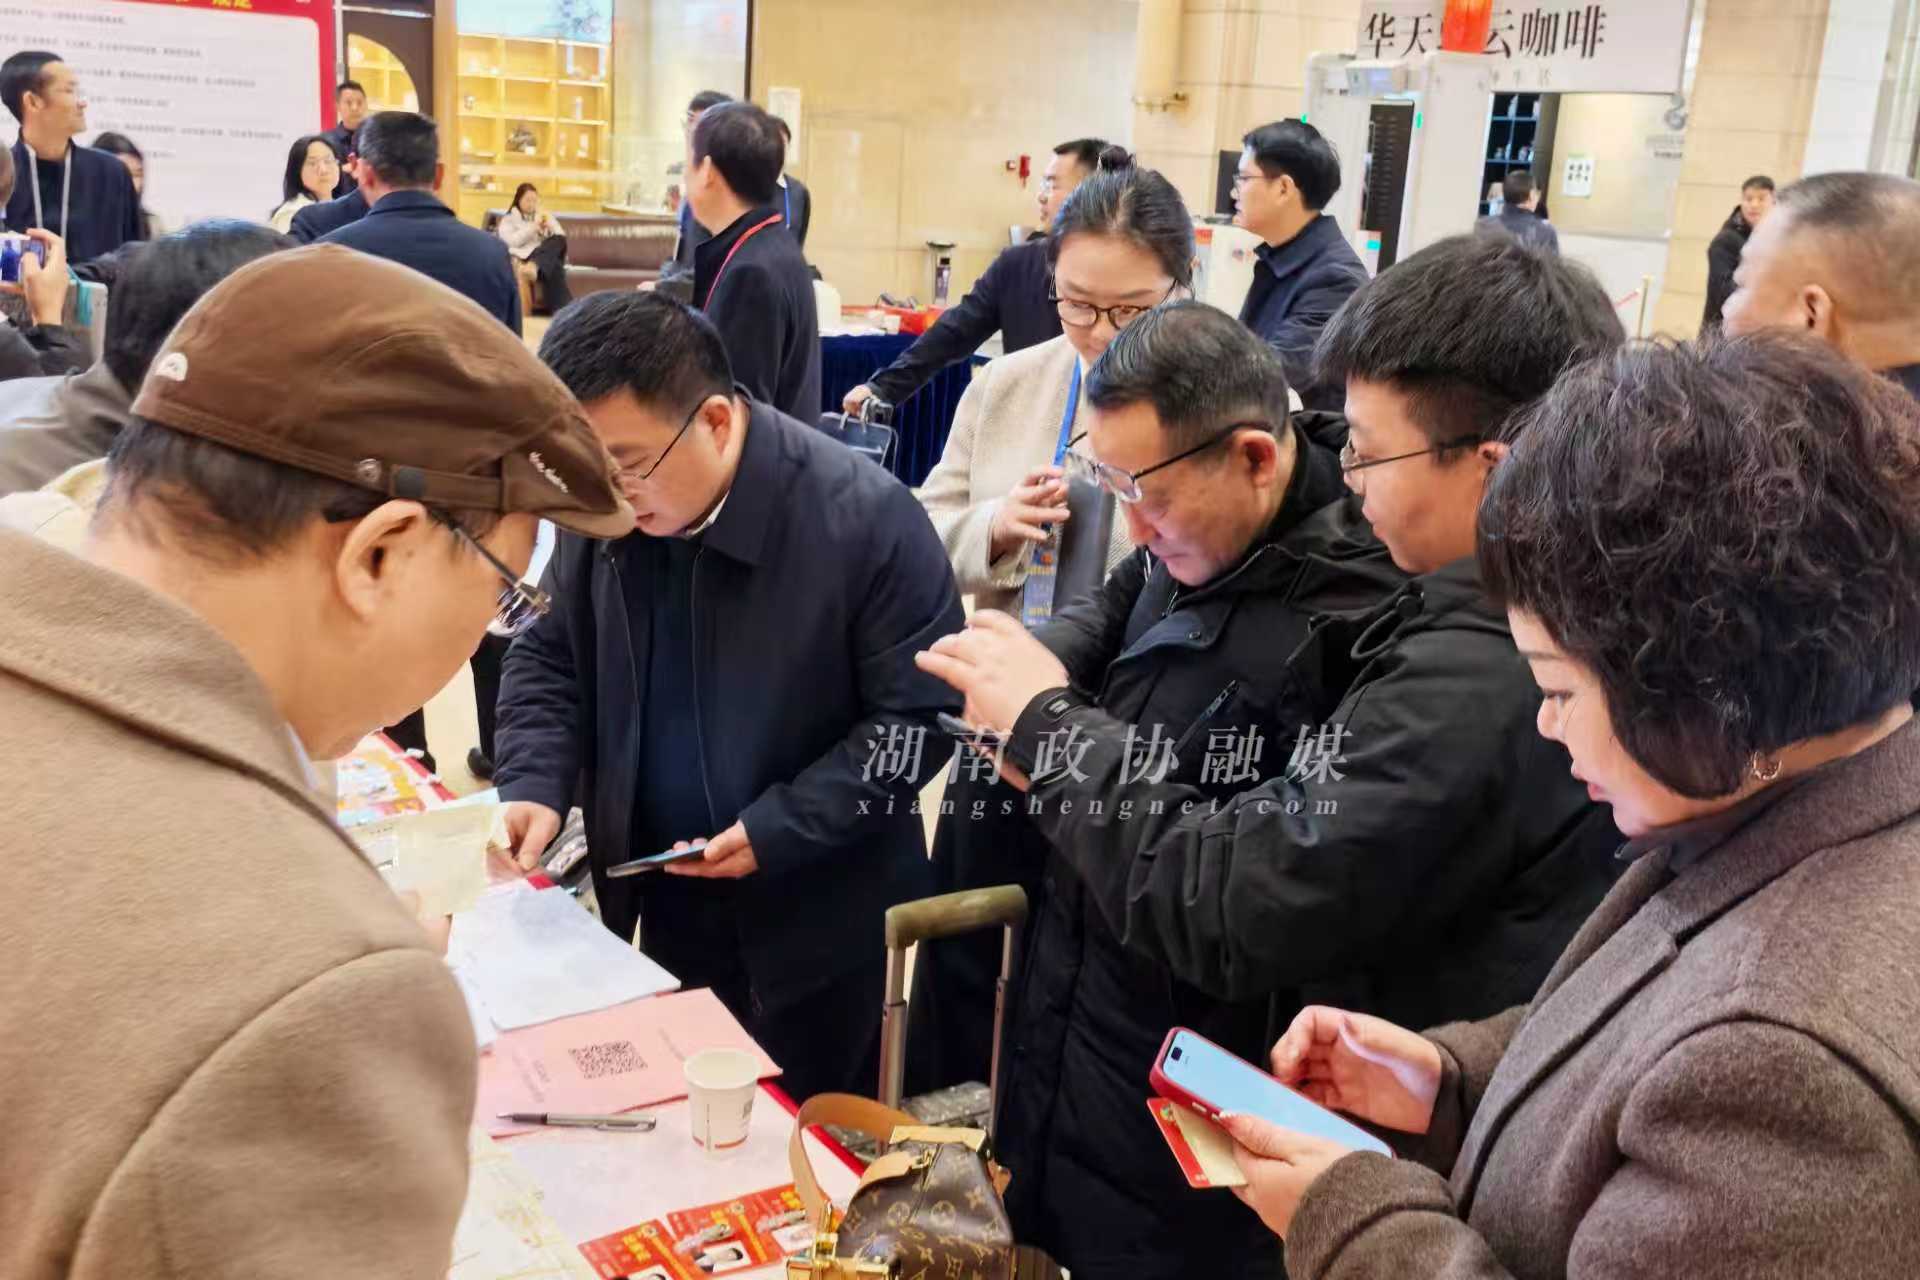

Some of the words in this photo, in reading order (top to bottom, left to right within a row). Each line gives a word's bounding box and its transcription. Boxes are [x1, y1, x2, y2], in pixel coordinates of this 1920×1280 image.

[1365, 5, 1606, 58] 华天云咖啡
